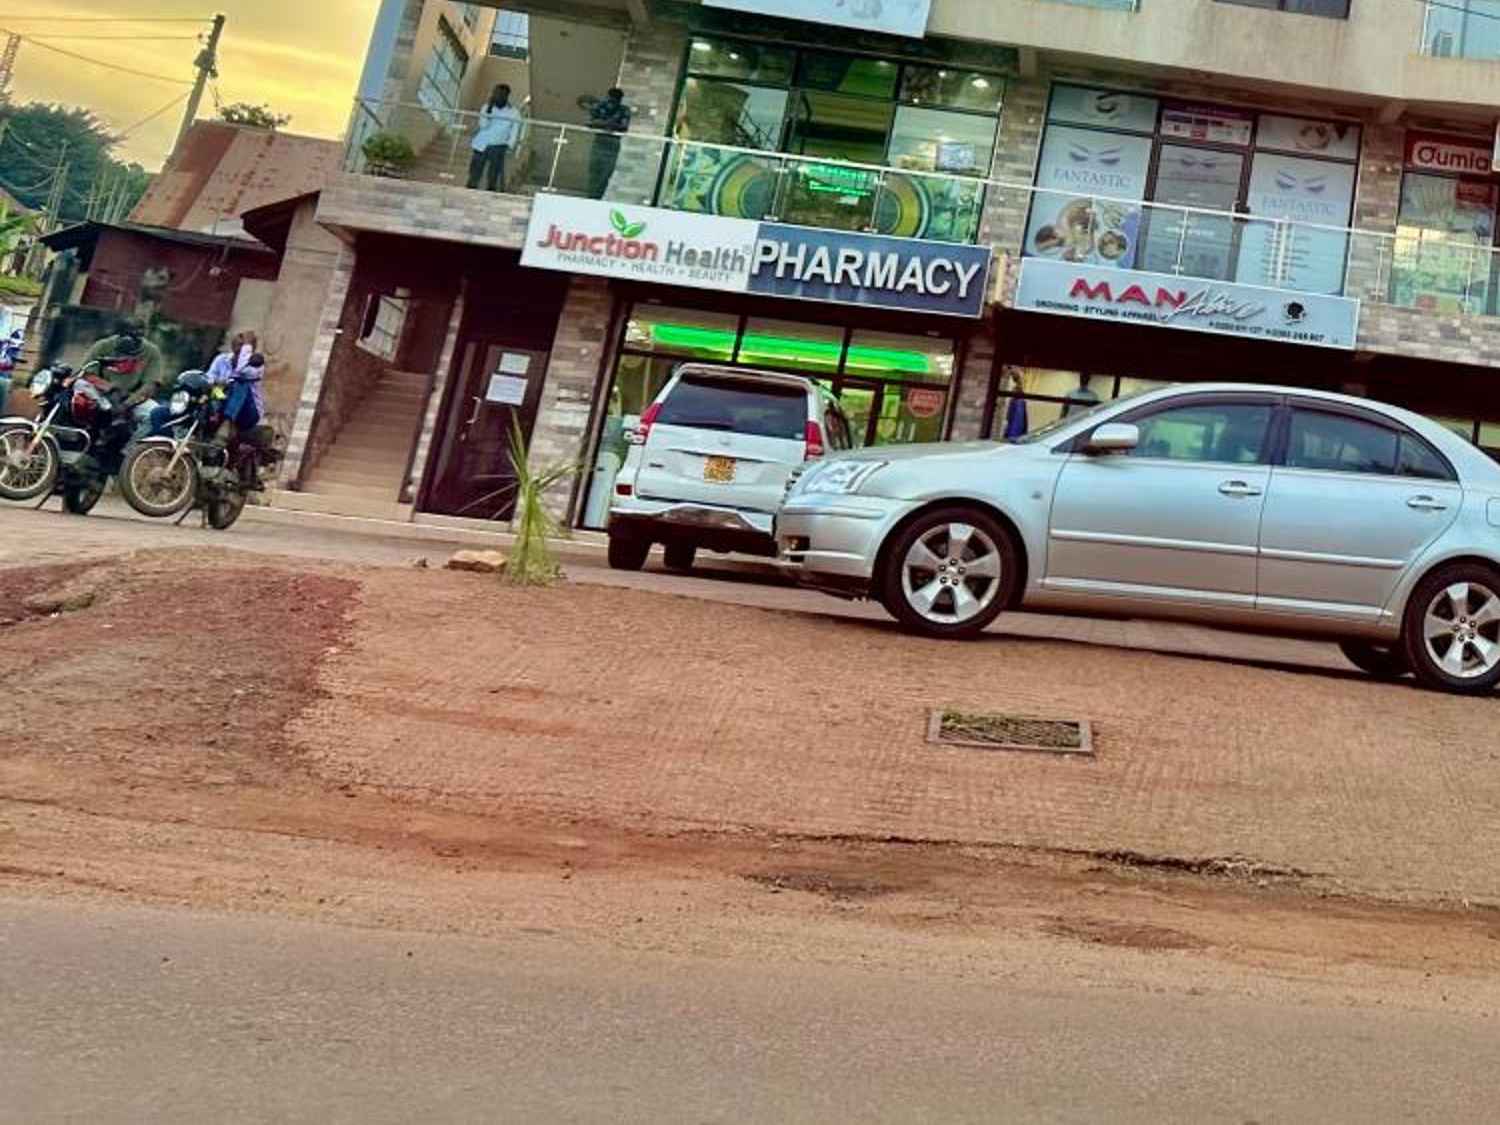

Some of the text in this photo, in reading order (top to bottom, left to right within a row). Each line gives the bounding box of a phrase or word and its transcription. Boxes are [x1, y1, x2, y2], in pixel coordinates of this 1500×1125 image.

[537, 224, 980, 299] Junction Health PHARMACY
[631, 261, 675, 276] HEALTH
[688, 268, 731, 283] BEAUTY
[1068, 277, 1187, 309] MAN
